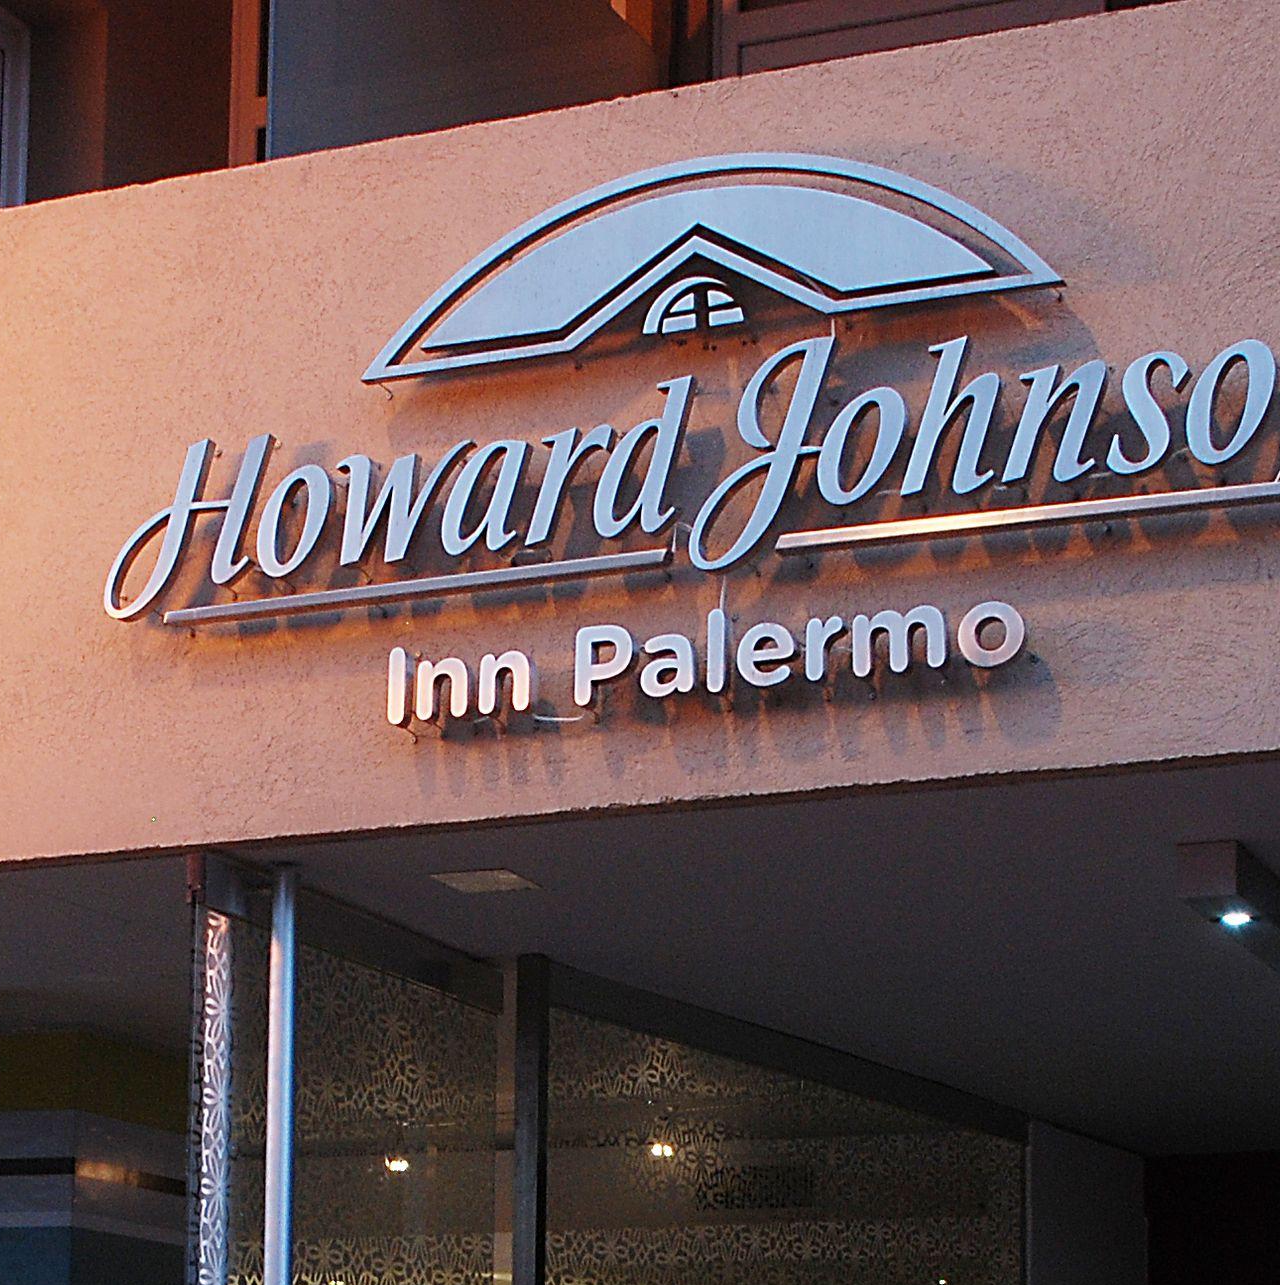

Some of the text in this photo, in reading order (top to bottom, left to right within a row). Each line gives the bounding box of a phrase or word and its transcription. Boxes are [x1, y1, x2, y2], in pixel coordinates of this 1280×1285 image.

[103, 374, 695, 620] Howard
[387, 600, 1025, 726] Inn Palermo
